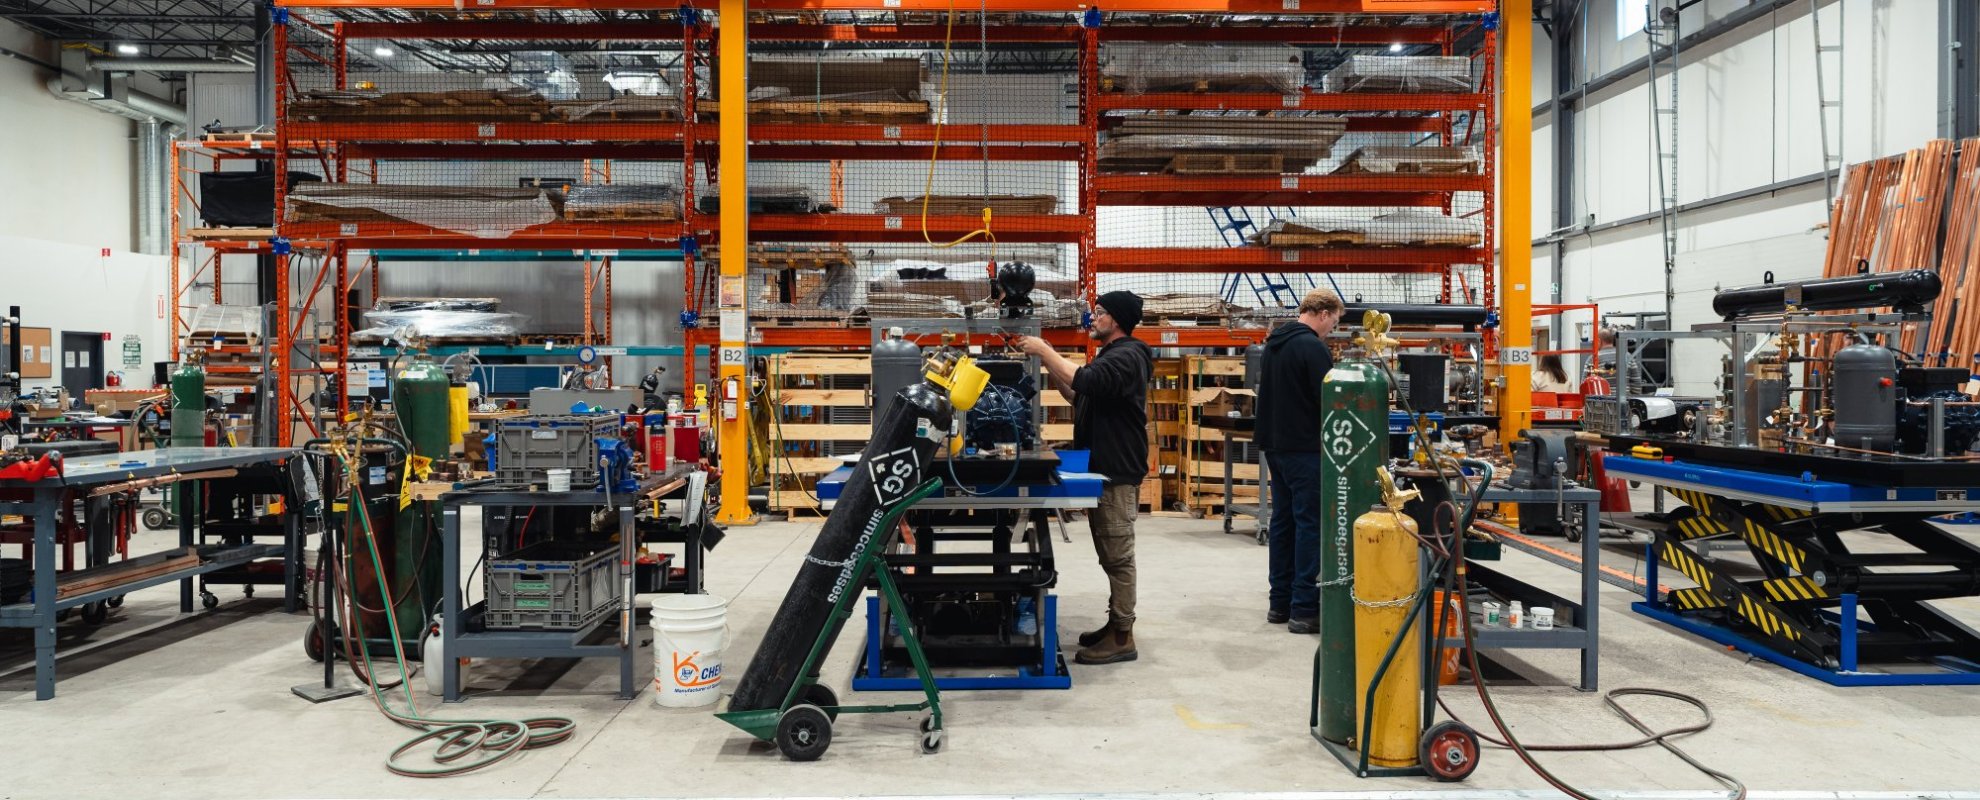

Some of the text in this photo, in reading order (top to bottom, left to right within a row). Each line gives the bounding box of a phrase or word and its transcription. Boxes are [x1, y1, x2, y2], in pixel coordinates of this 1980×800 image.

[724, 350, 742, 361] B2
[1512, 350, 1530, 362] B3
[1332, 419, 1353, 456] SG
[882, 459, 913, 495] SG
[701, 664, 721, 679] CHE
